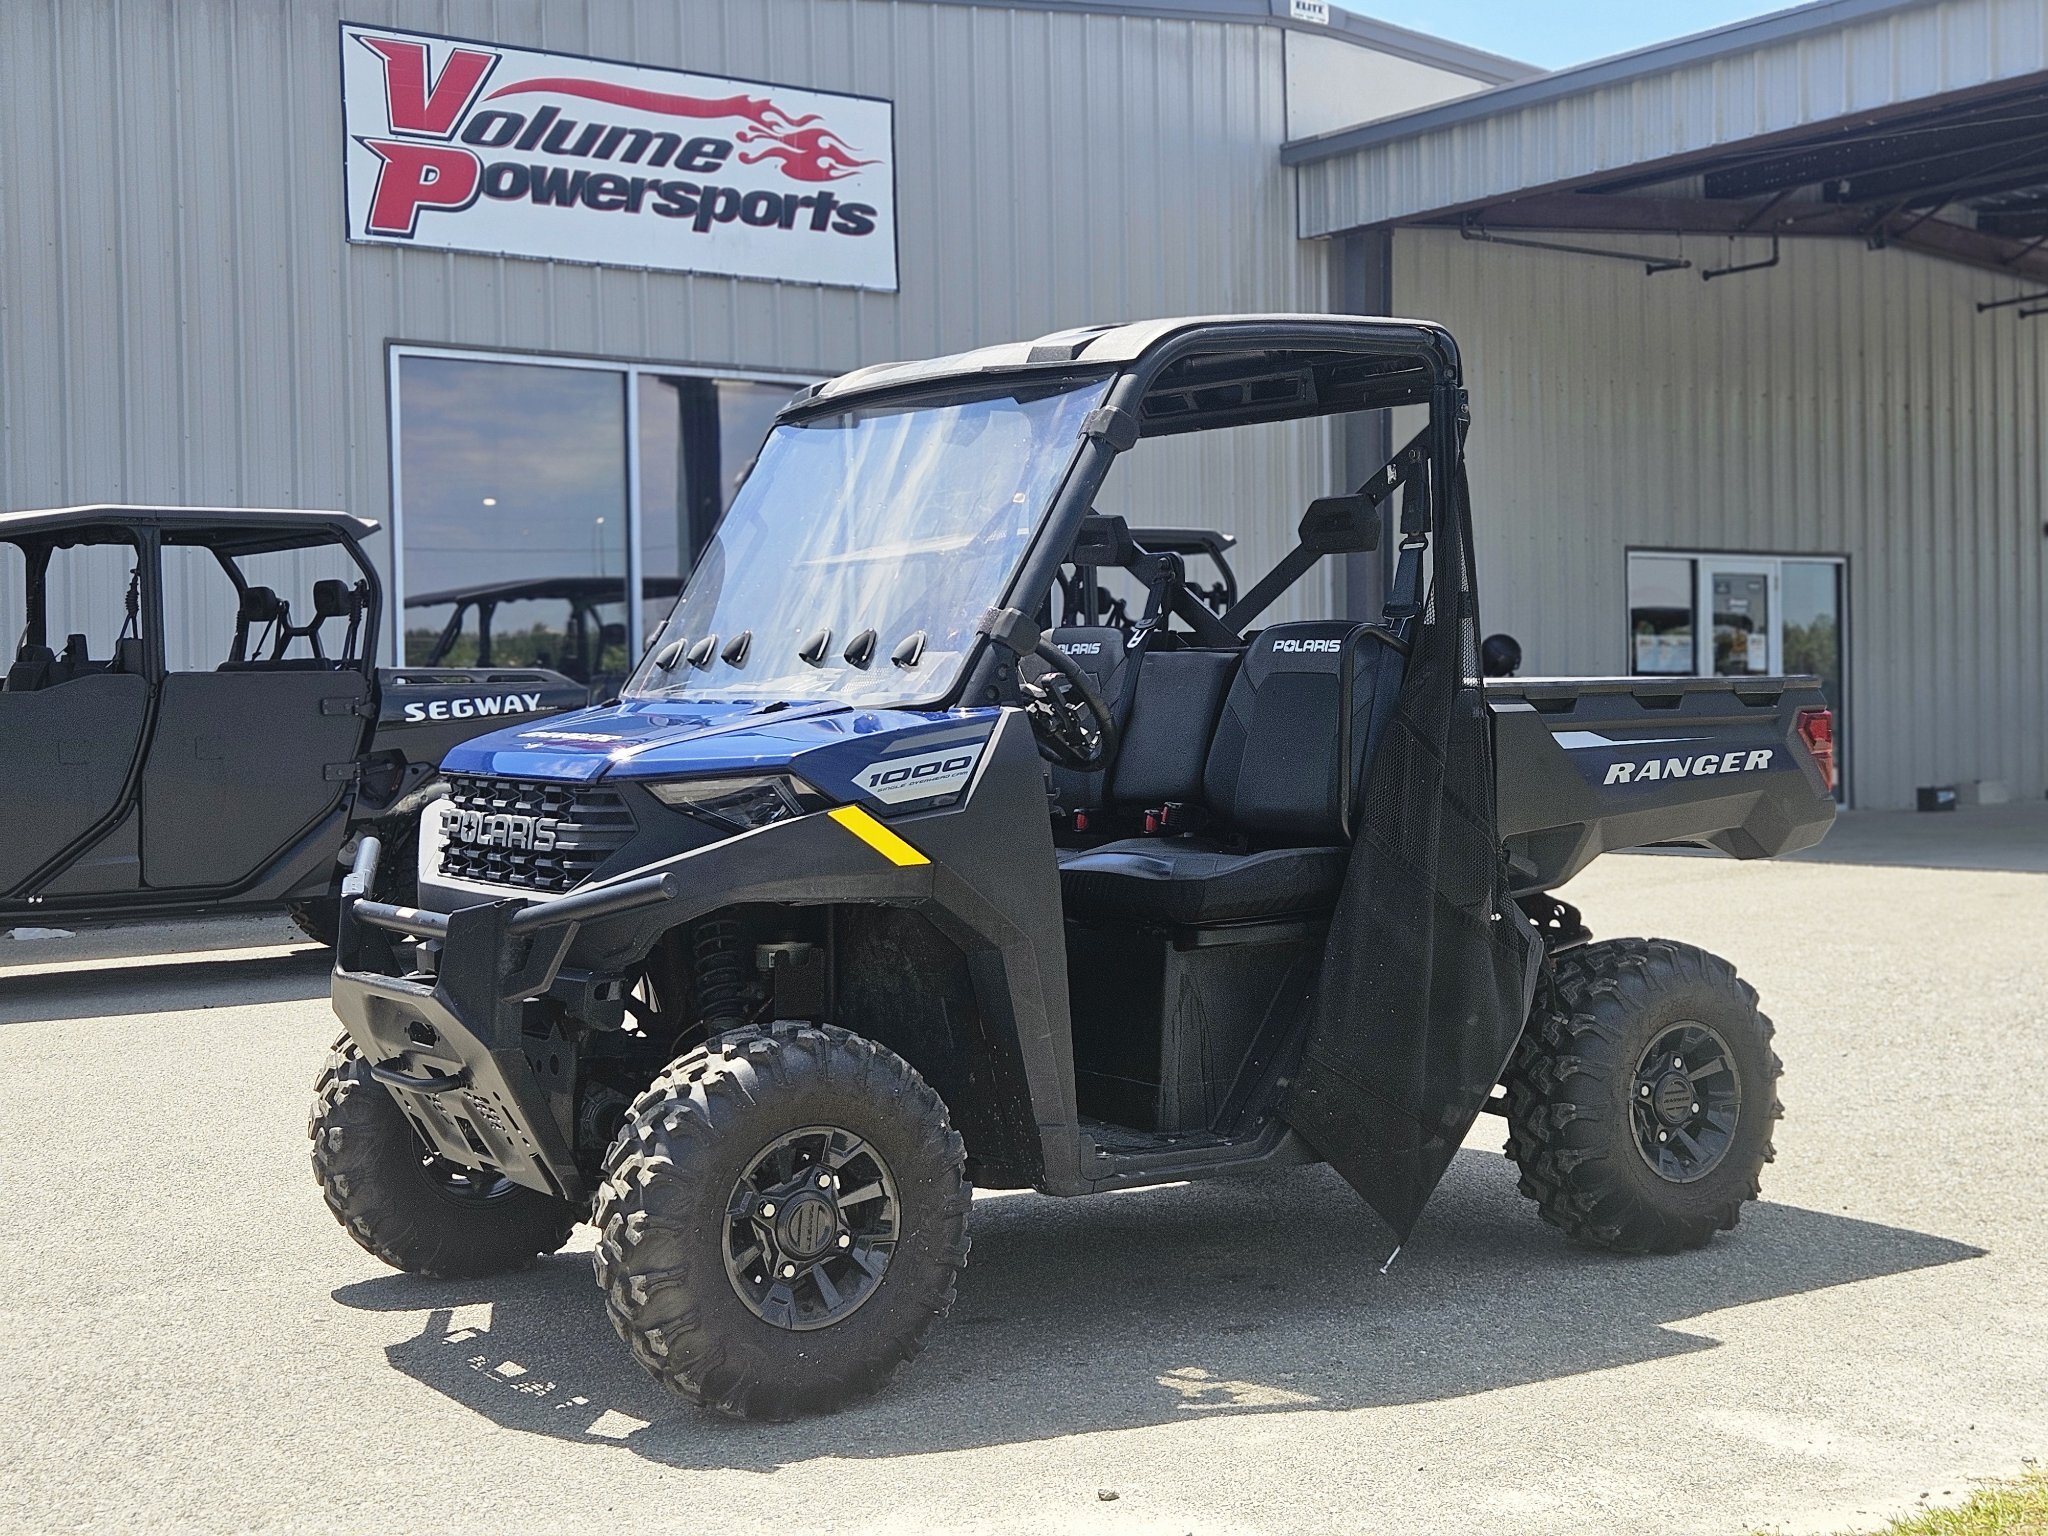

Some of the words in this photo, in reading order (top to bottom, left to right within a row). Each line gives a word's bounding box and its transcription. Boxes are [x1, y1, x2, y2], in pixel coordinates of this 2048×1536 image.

[348, 32, 734, 174] Volume
[350, 135, 879, 239] Powersports
[1057, 642, 1102, 655] OLARIS
[1272, 639, 1342, 653] POLARIS
[403, 692, 542, 722] SEGWAY
[869, 756, 972, 787] 1000
[1602, 749, 1774, 785] RANGER
[447, 808, 557, 852] POLARIS
